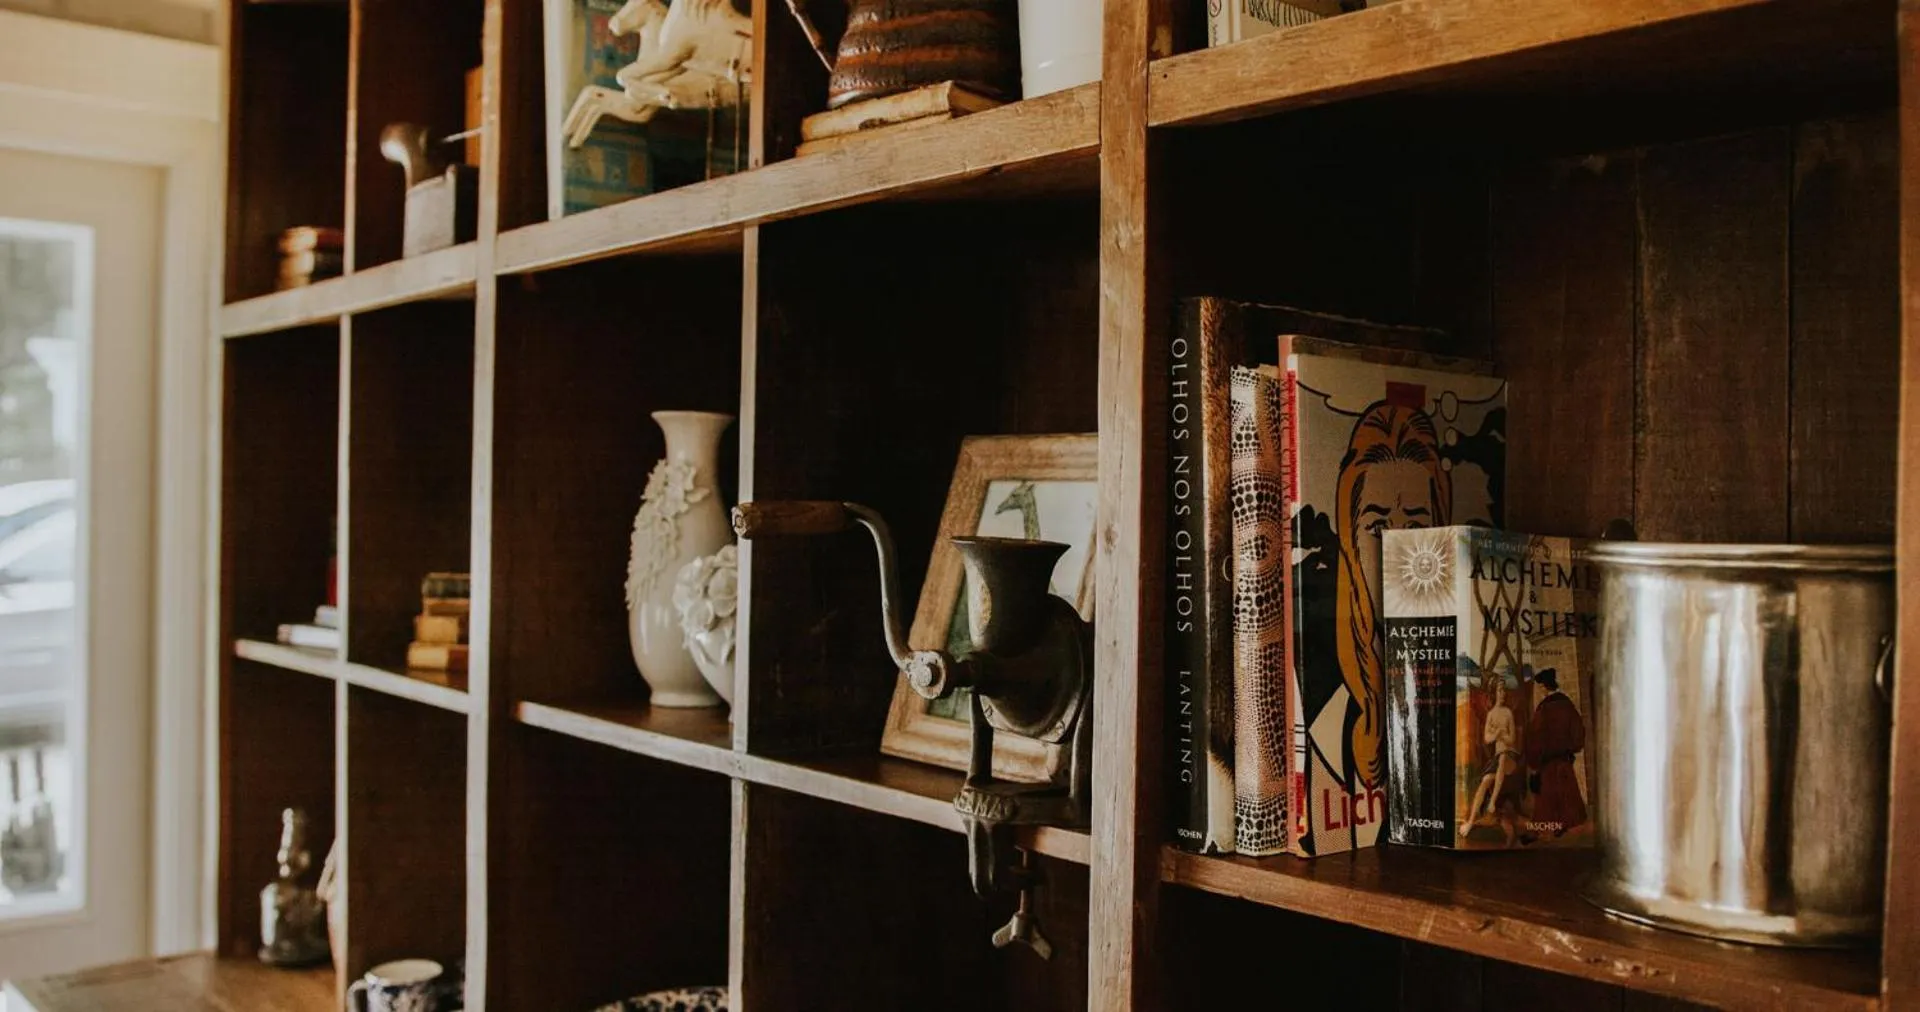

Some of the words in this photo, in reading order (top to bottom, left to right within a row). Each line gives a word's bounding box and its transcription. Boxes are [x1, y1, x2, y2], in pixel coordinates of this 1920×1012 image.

[1171, 338, 1189, 441] OLHOS
[1173, 455, 1191, 516] NOS
[1174, 529, 1193, 633] OLHOS
[1529, 590, 1537, 604] &
[1389, 625, 1455, 638] ALCHEMIE
[1484, 605, 1598, 638] MYSTIEK
[1396, 649, 1451, 661] MYSTIEK
[1179, 670, 1193, 784] LANTING
[1323, 779, 1386, 831] Lich
[1407, 818, 1444, 830] TASCHEN
[1526, 821, 1563, 831] TASCHEN
